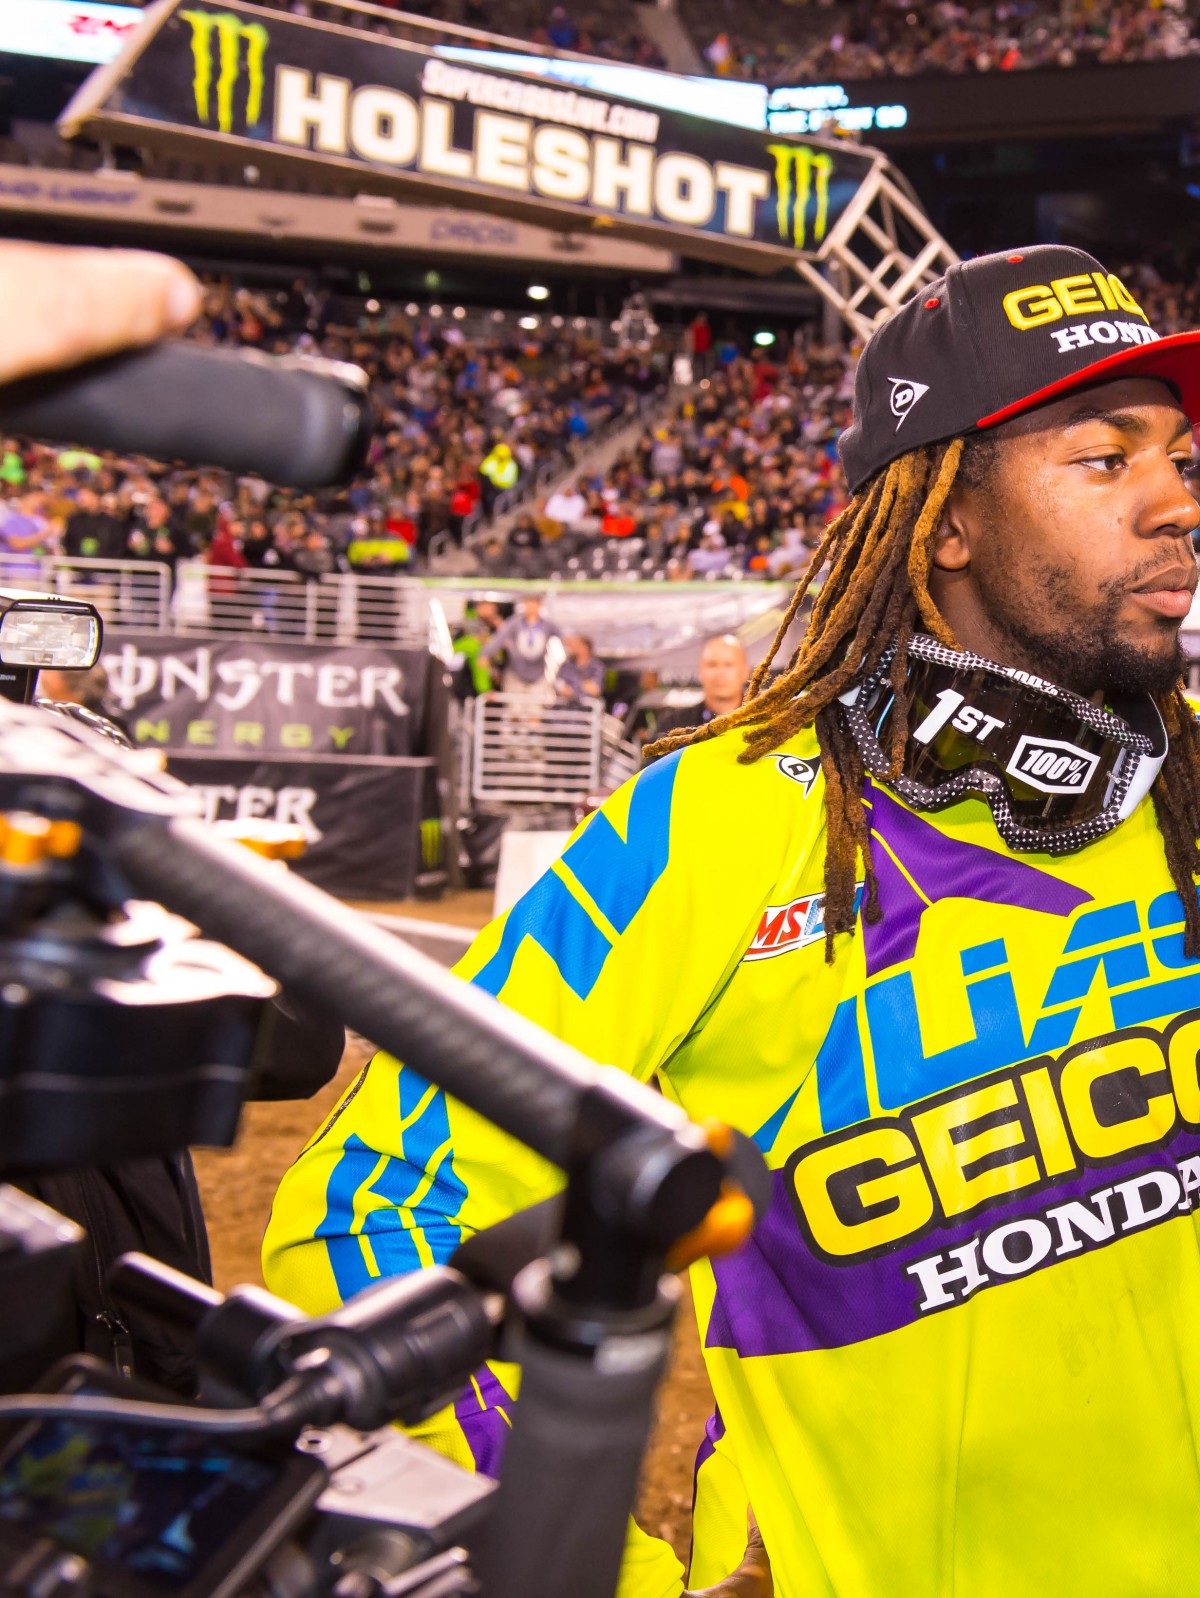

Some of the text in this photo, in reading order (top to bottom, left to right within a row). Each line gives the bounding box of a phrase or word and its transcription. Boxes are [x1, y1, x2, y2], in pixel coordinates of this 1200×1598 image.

[273, 63, 772, 240] HOLESHOT
[103, 643, 410, 717] ONSTER
[134, 718, 356, 749] NERGY
[1021, 748, 1089, 786] 100%
